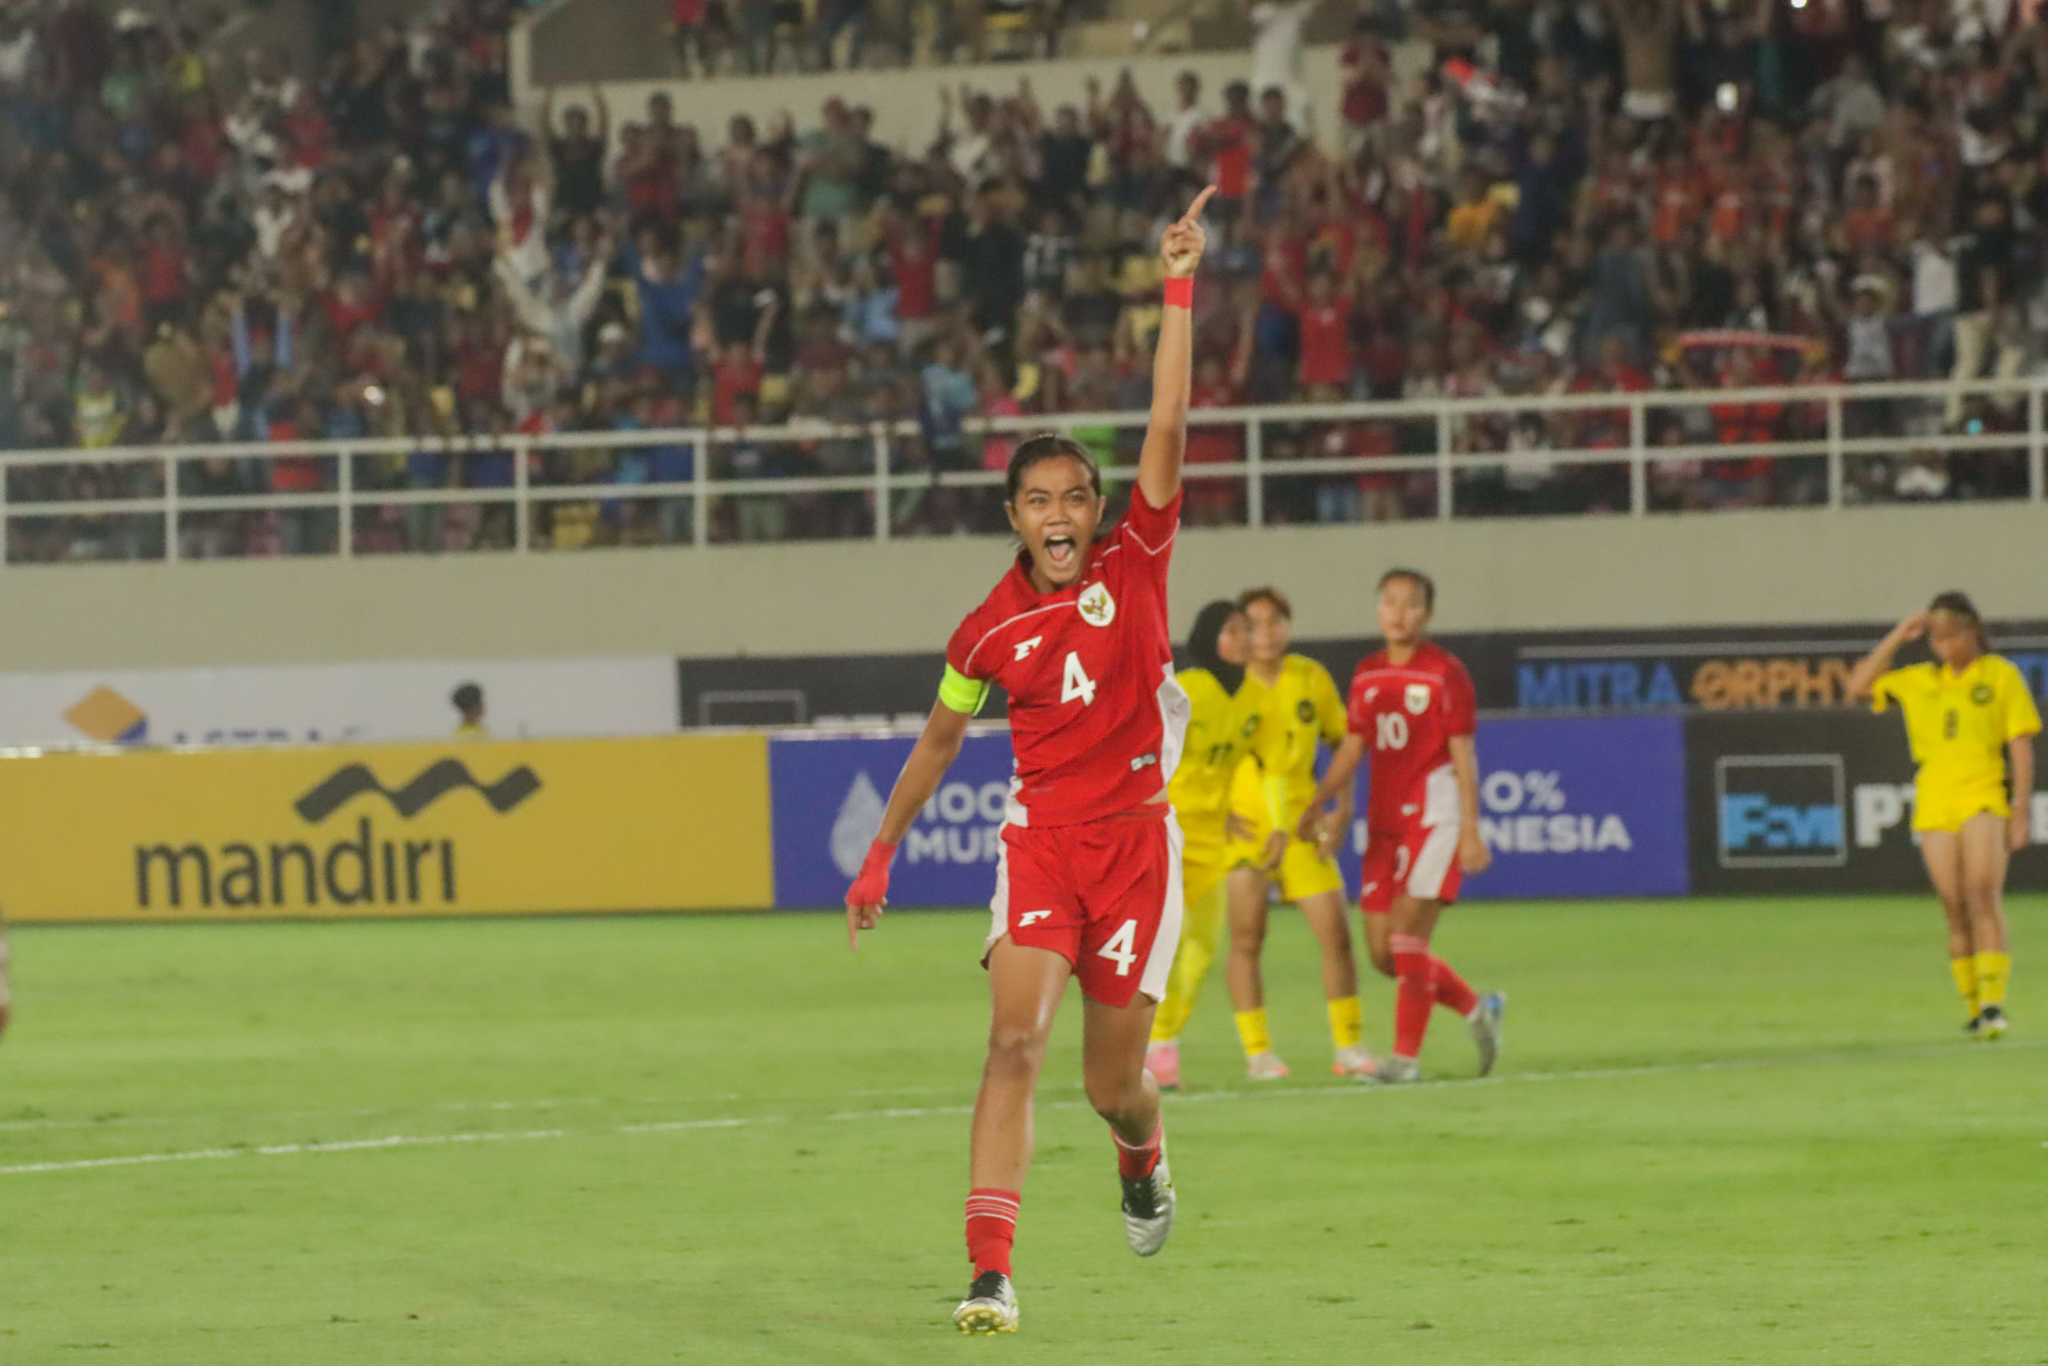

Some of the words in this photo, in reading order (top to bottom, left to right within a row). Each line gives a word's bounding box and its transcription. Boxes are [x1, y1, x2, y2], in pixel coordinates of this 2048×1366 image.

[1060, 650, 1096, 706] 4
[1517, 661, 1685, 708] MITRA
[1376, 711, 1409, 751] 10
[134, 816, 456, 908] mandiri
[1097, 919, 1138, 976] 4
